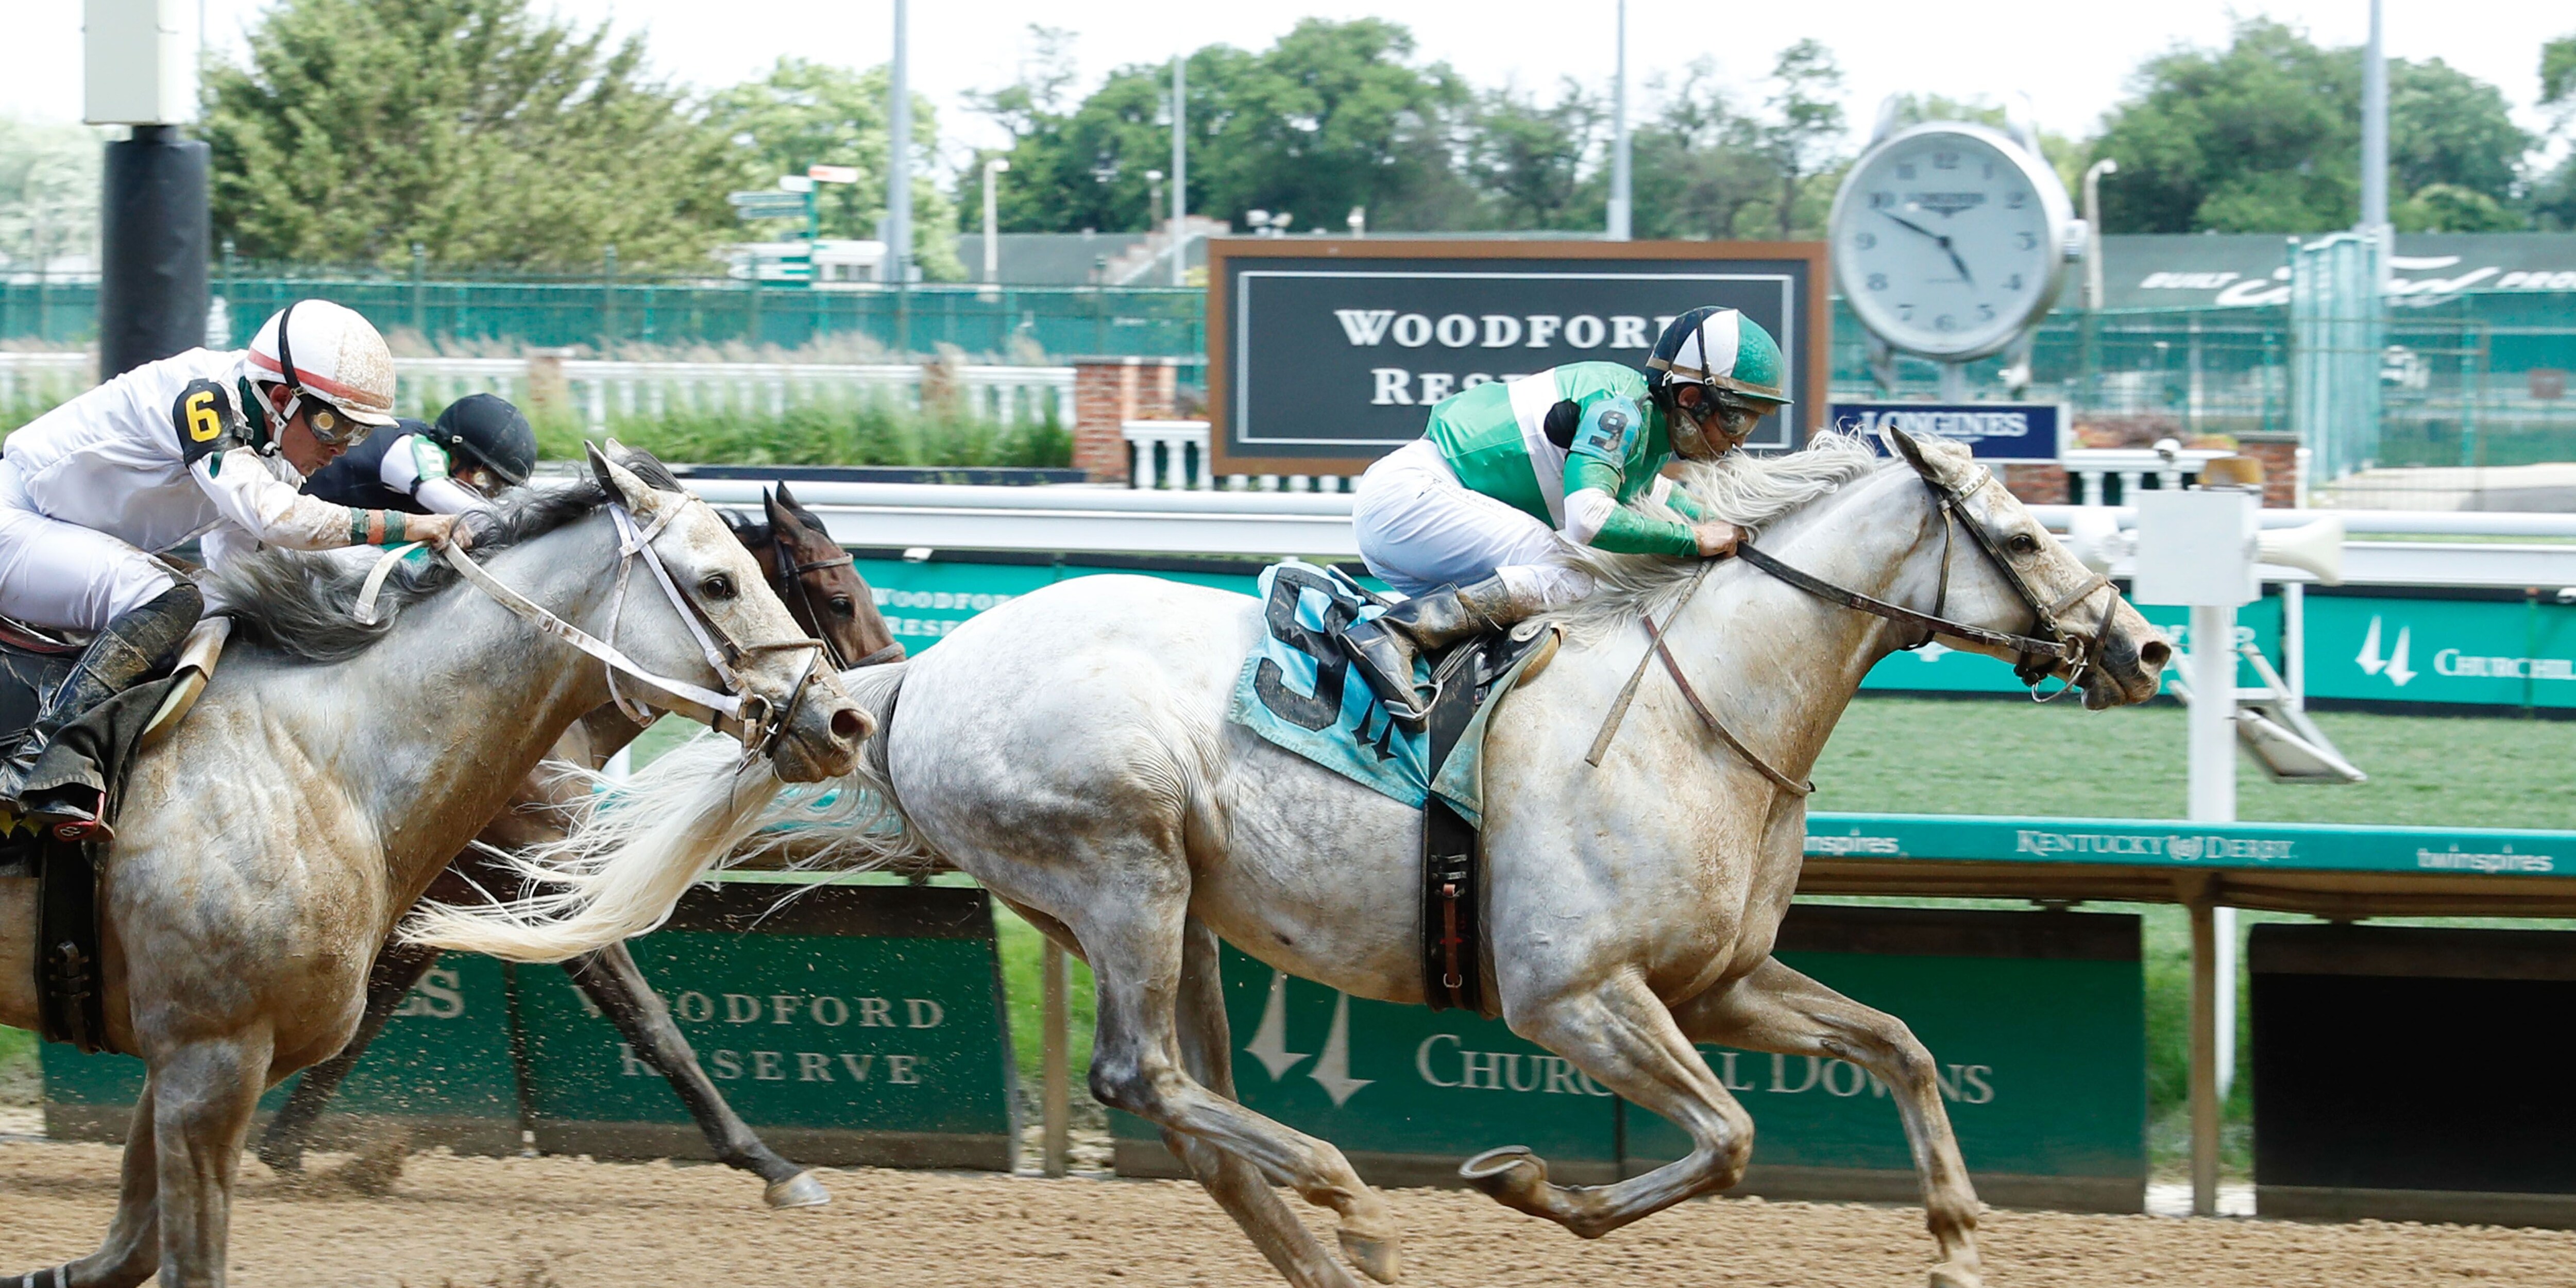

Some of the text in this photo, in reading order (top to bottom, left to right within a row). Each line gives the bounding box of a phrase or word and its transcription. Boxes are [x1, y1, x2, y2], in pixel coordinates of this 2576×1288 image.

[1855, 233, 1877, 250] 9
[1867, 273, 1888, 291] 8
[1934, 313, 1956, 331] 6
[185, 390, 222, 443] 6
[1588, 410, 1629, 451] 9
[418, 444, 445, 472] 5
[1254, 567, 1359, 732] 9
[2015, 830, 2295, 861] KENTUCKY DERBY
[569, 985, 944, 1029] ODFORD
[617, 1042, 921, 1085] RSERVE
